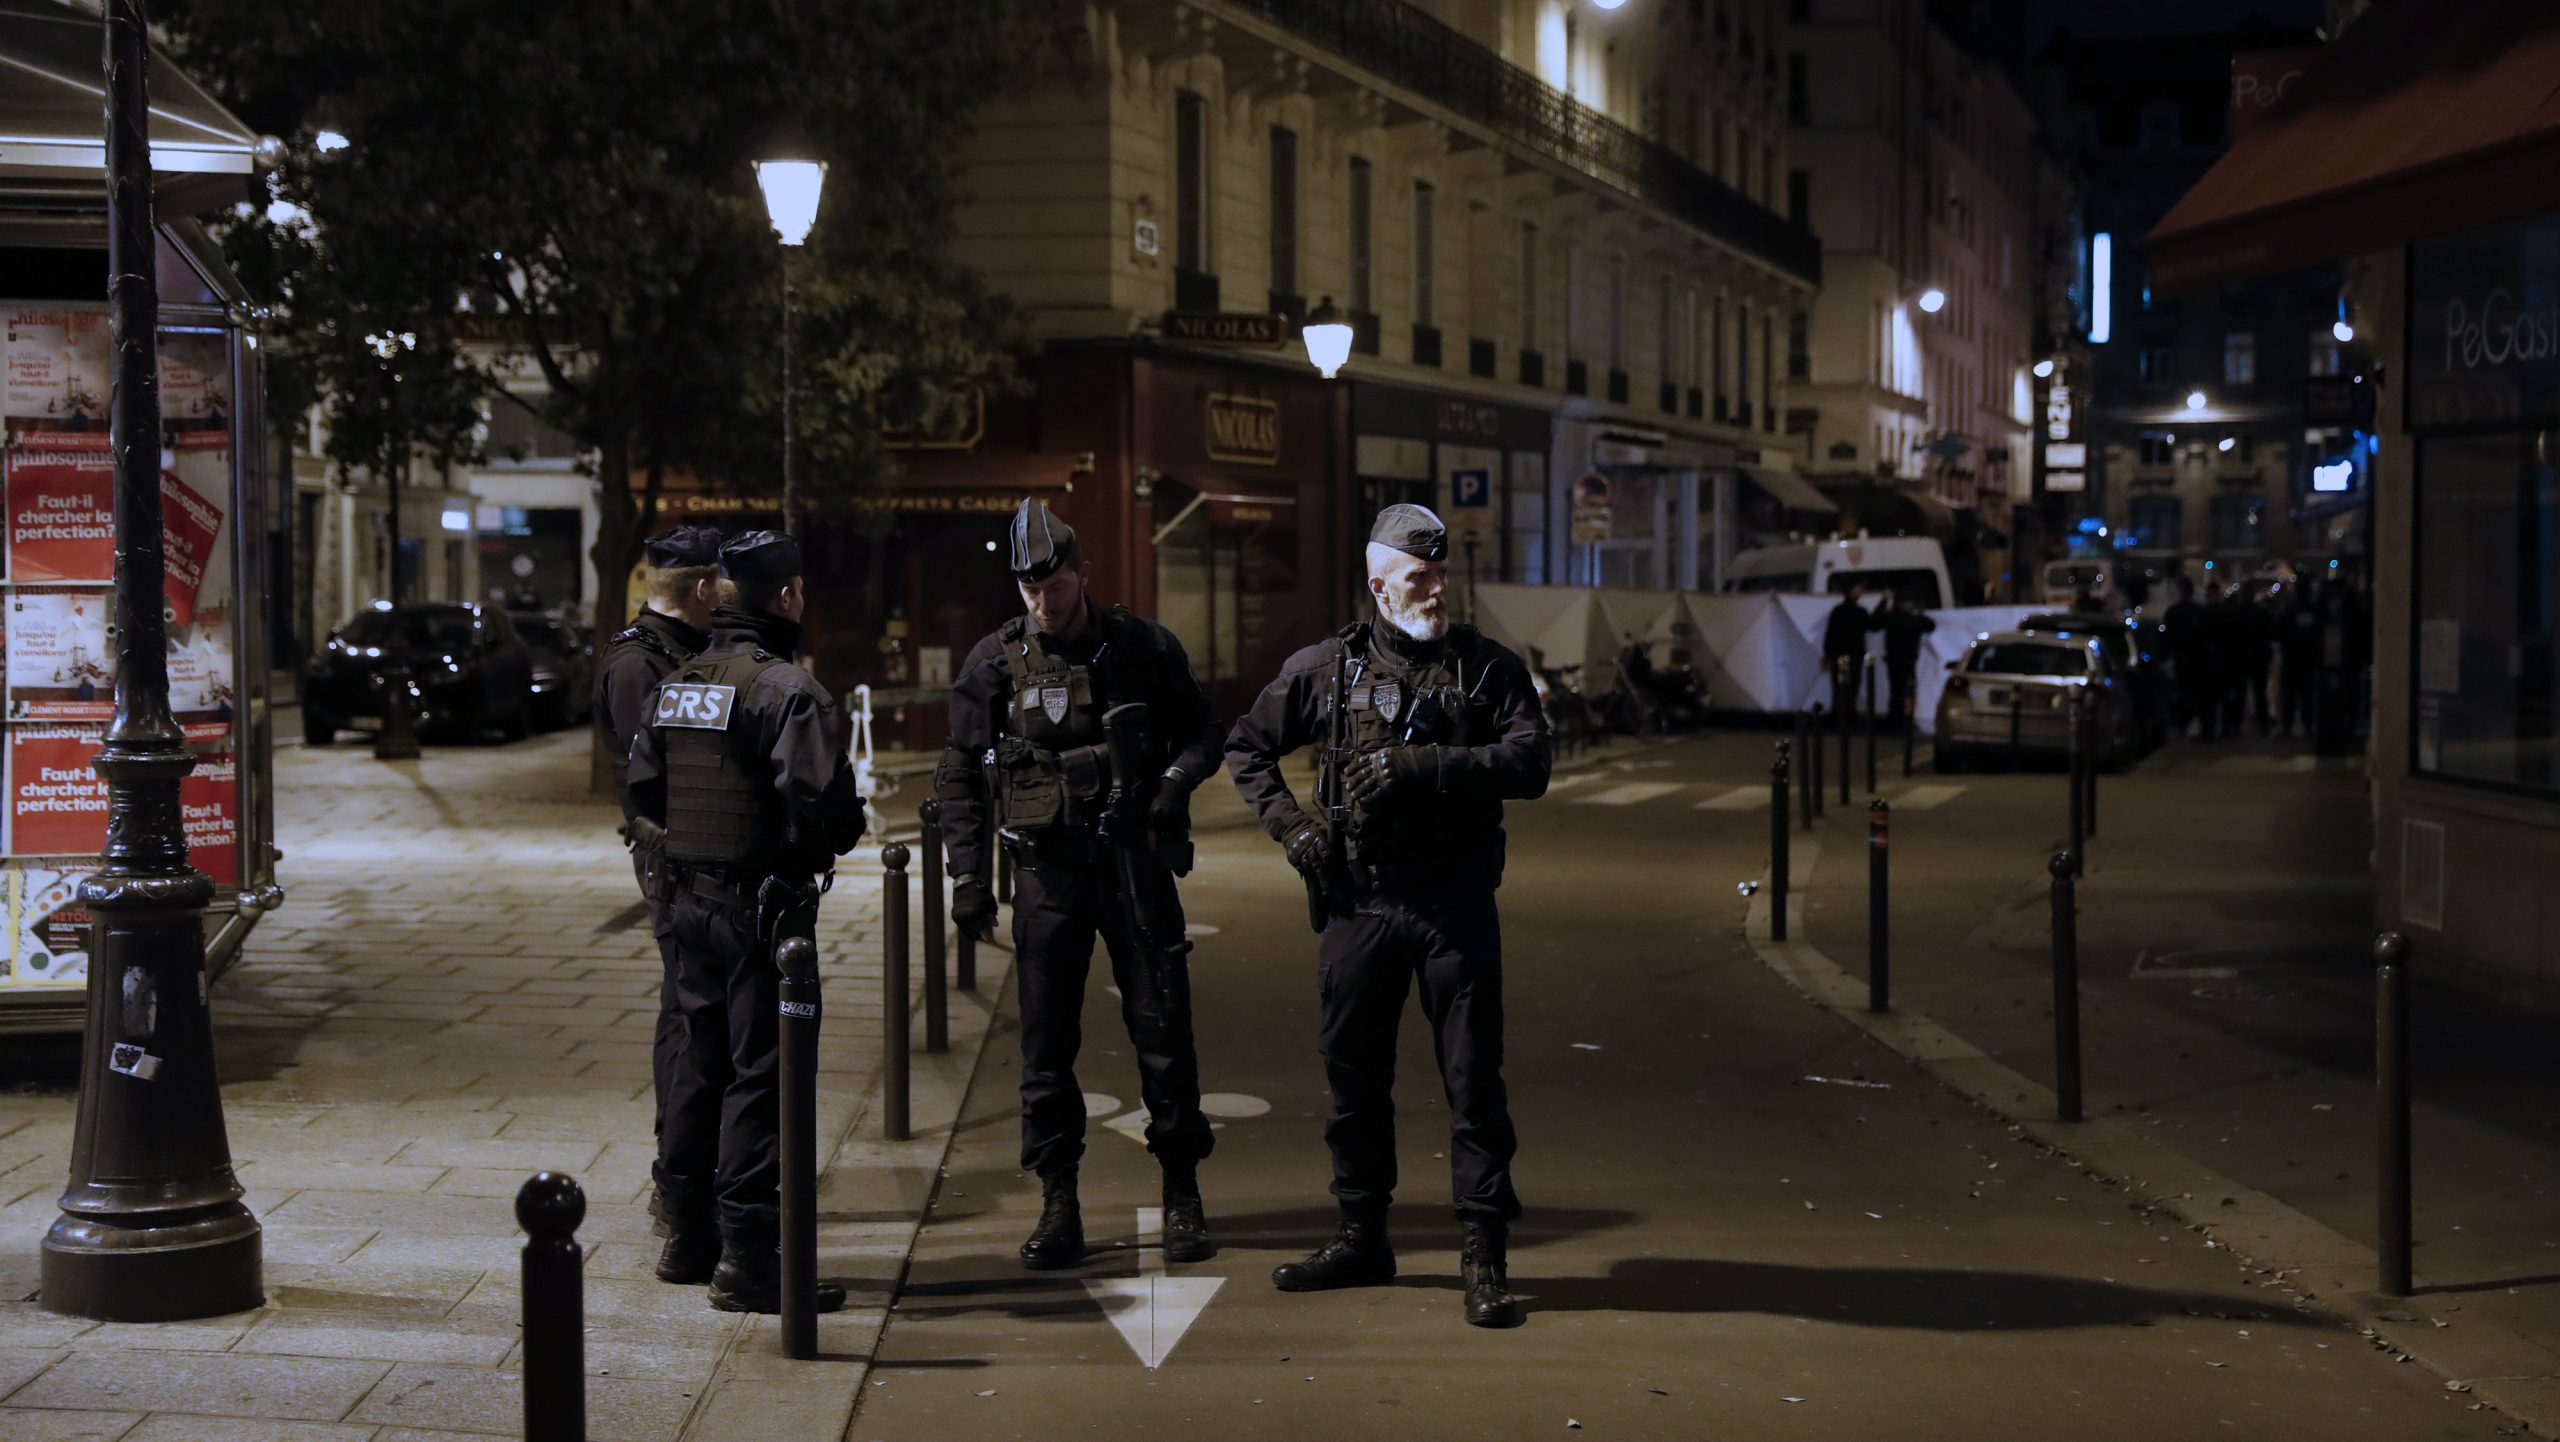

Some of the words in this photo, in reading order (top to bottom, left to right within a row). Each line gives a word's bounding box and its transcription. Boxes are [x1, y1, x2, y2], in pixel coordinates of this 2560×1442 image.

[1176, 318, 1271, 340] NICOLAS
[1211, 407, 1276, 451] NICOLAS
[11, 450, 114, 473] philosophi
[1459, 474, 1480, 503] P
[37, 493, 94, 508] Faut-il
[160, 474, 220, 530] hilosophie
[17, 509, 93, 524] chercher
[95, 508, 113, 523] la
[14, 523, 116, 544] perfection?
[162, 527, 194, 556] aut-il
[658, 689, 724, 721] CRS
[1044, 698, 1066, 709] CRS
[14, 723, 105, 745] philosoph
[40, 766, 97, 782] Faut-il
[20, 781, 97, 797] chercher
[16, 796, 108, 816] perfection
[181, 803, 222, 819] Faut-il
[181, 818, 221, 834] ercher
[184, 830, 237, 848] fection?
